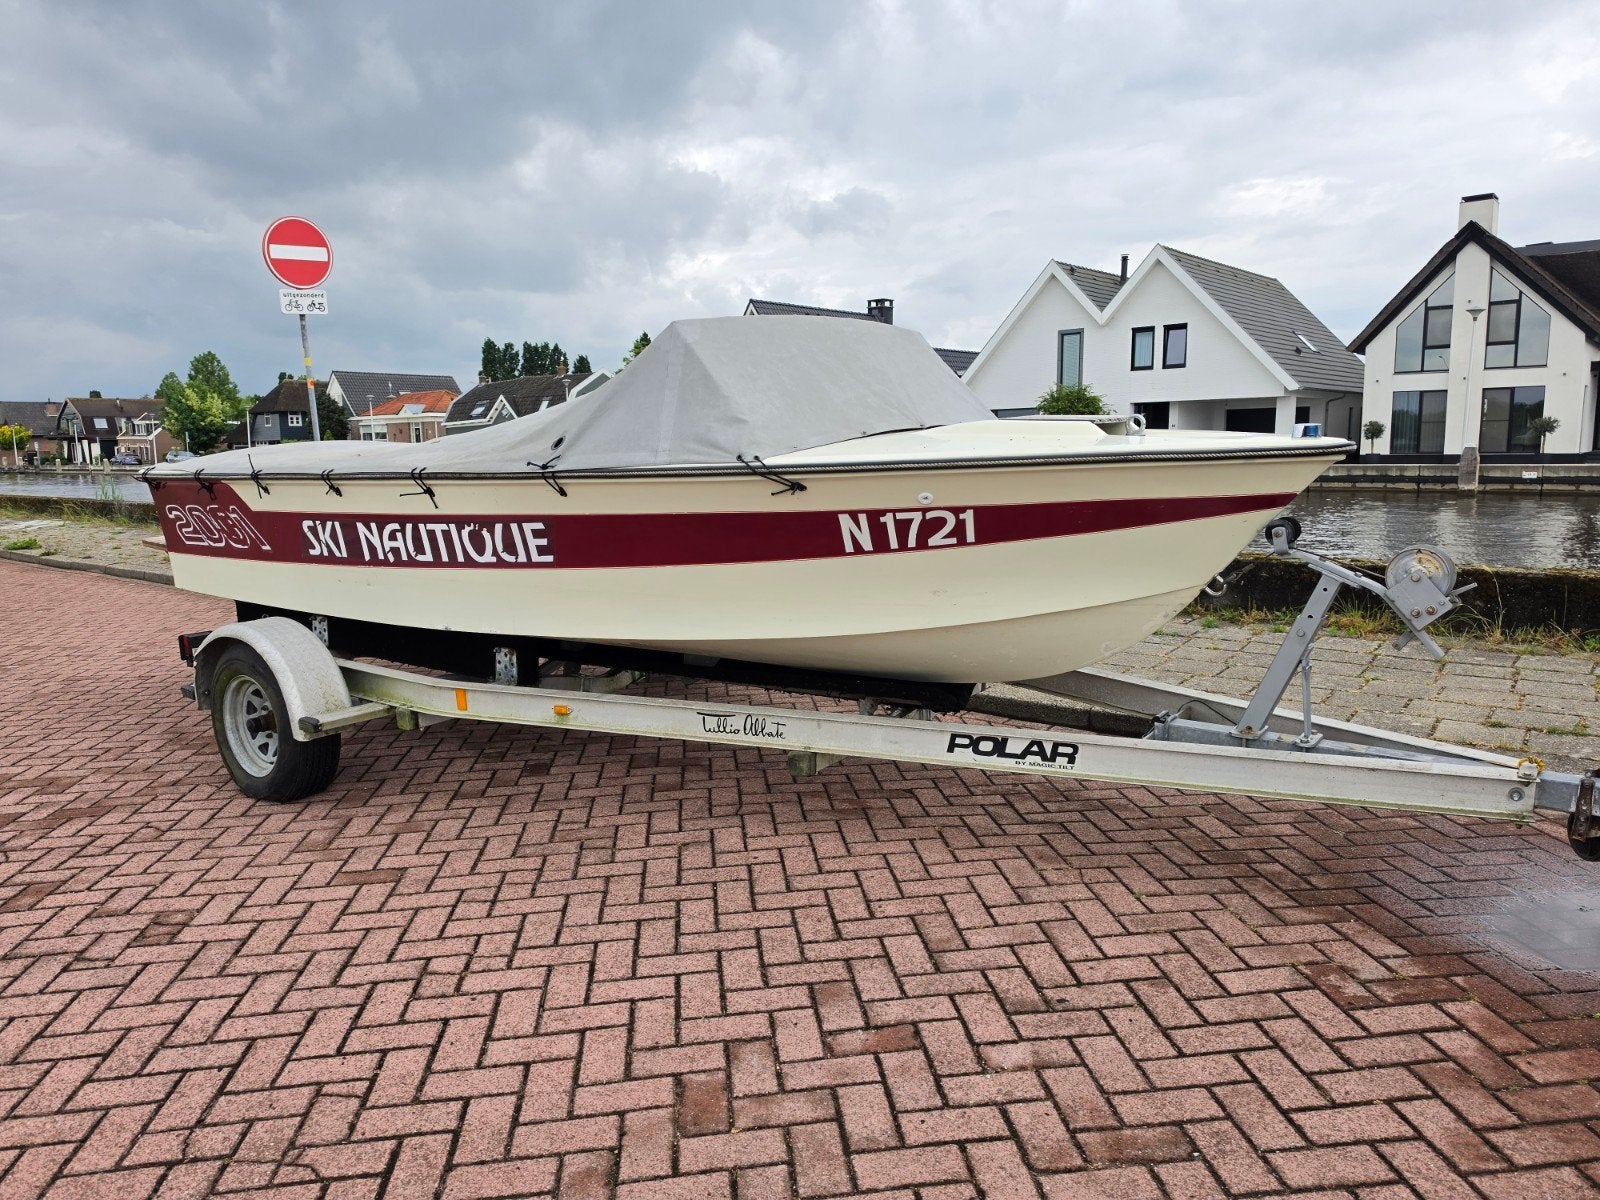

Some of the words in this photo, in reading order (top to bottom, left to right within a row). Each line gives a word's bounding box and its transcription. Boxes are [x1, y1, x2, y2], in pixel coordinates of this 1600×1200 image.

[302, 519, 348, 558] SKI
[356, 522, 554, 563] NAUTIQUE
[837, 513, 874, 553] N
[879, 508, 976, 550] 1721
[743, 714, 787, 740] Abbate
[946, 733, 1080, 765] POLAR
[1029, 761, 1056, 769] MAGIC
